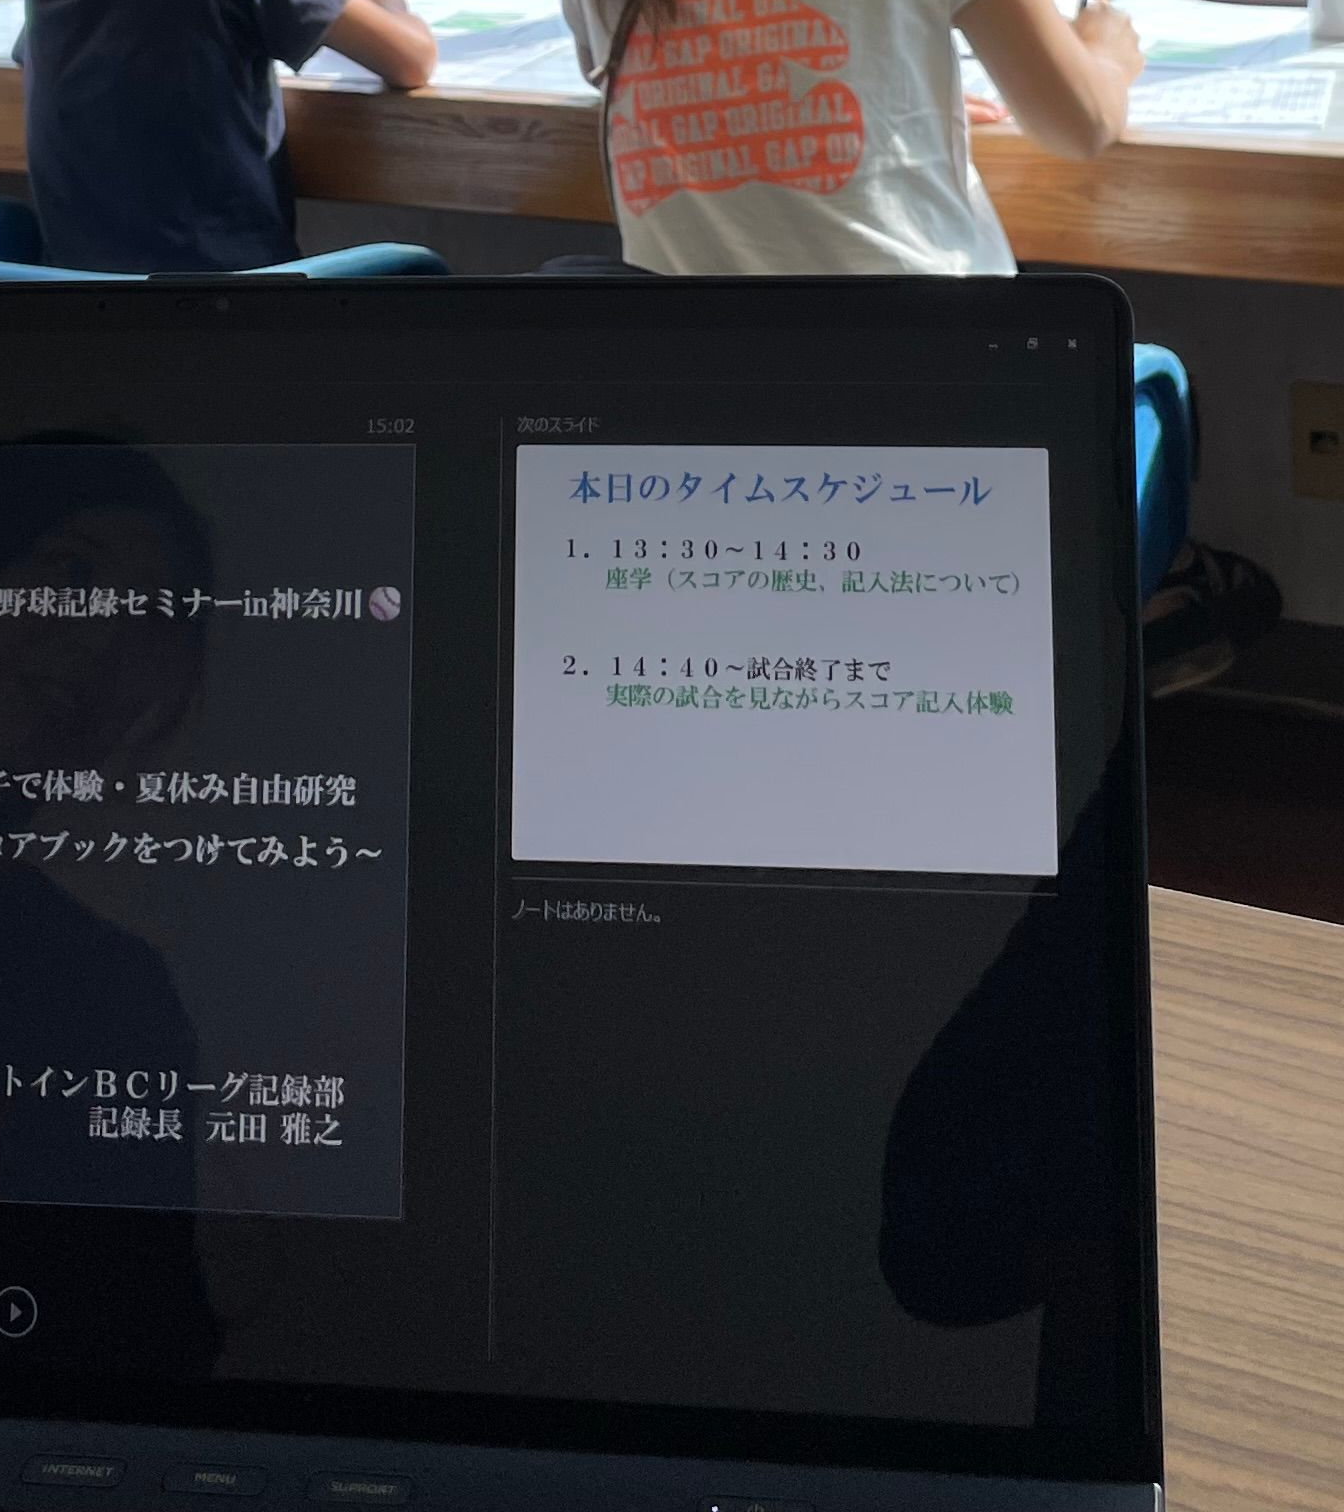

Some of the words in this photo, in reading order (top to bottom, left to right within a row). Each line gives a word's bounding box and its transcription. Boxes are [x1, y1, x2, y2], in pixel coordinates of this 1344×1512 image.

[664, 34, 712, 67] GAP
[719, 19, 847, 61] ORIGINAL
[637, 66, 746, 109] ORIGINAL
[671, 111, 718, 144] GAP
[724, 93, 853, 137] ORIGINAL
[764, 136, 818, 172] GAP
[367, 418, 415, 435] 15:02
[517, 416, 600, 433] 次のスライド
[569, 471, 993, 507] 本日のタイムスケジュール
[605, 684, 1015, 716] 実際の試合を見ながらスコア記入体験
[512, 899, 662, 923] ノートはありません。
[89, 1106, 184, 1140] 記録長
[206, 1112, 267, 1143] 元田
[280, 1113, 344, 1147] 雅之
[194, 1471, 236, 1485] MENU
